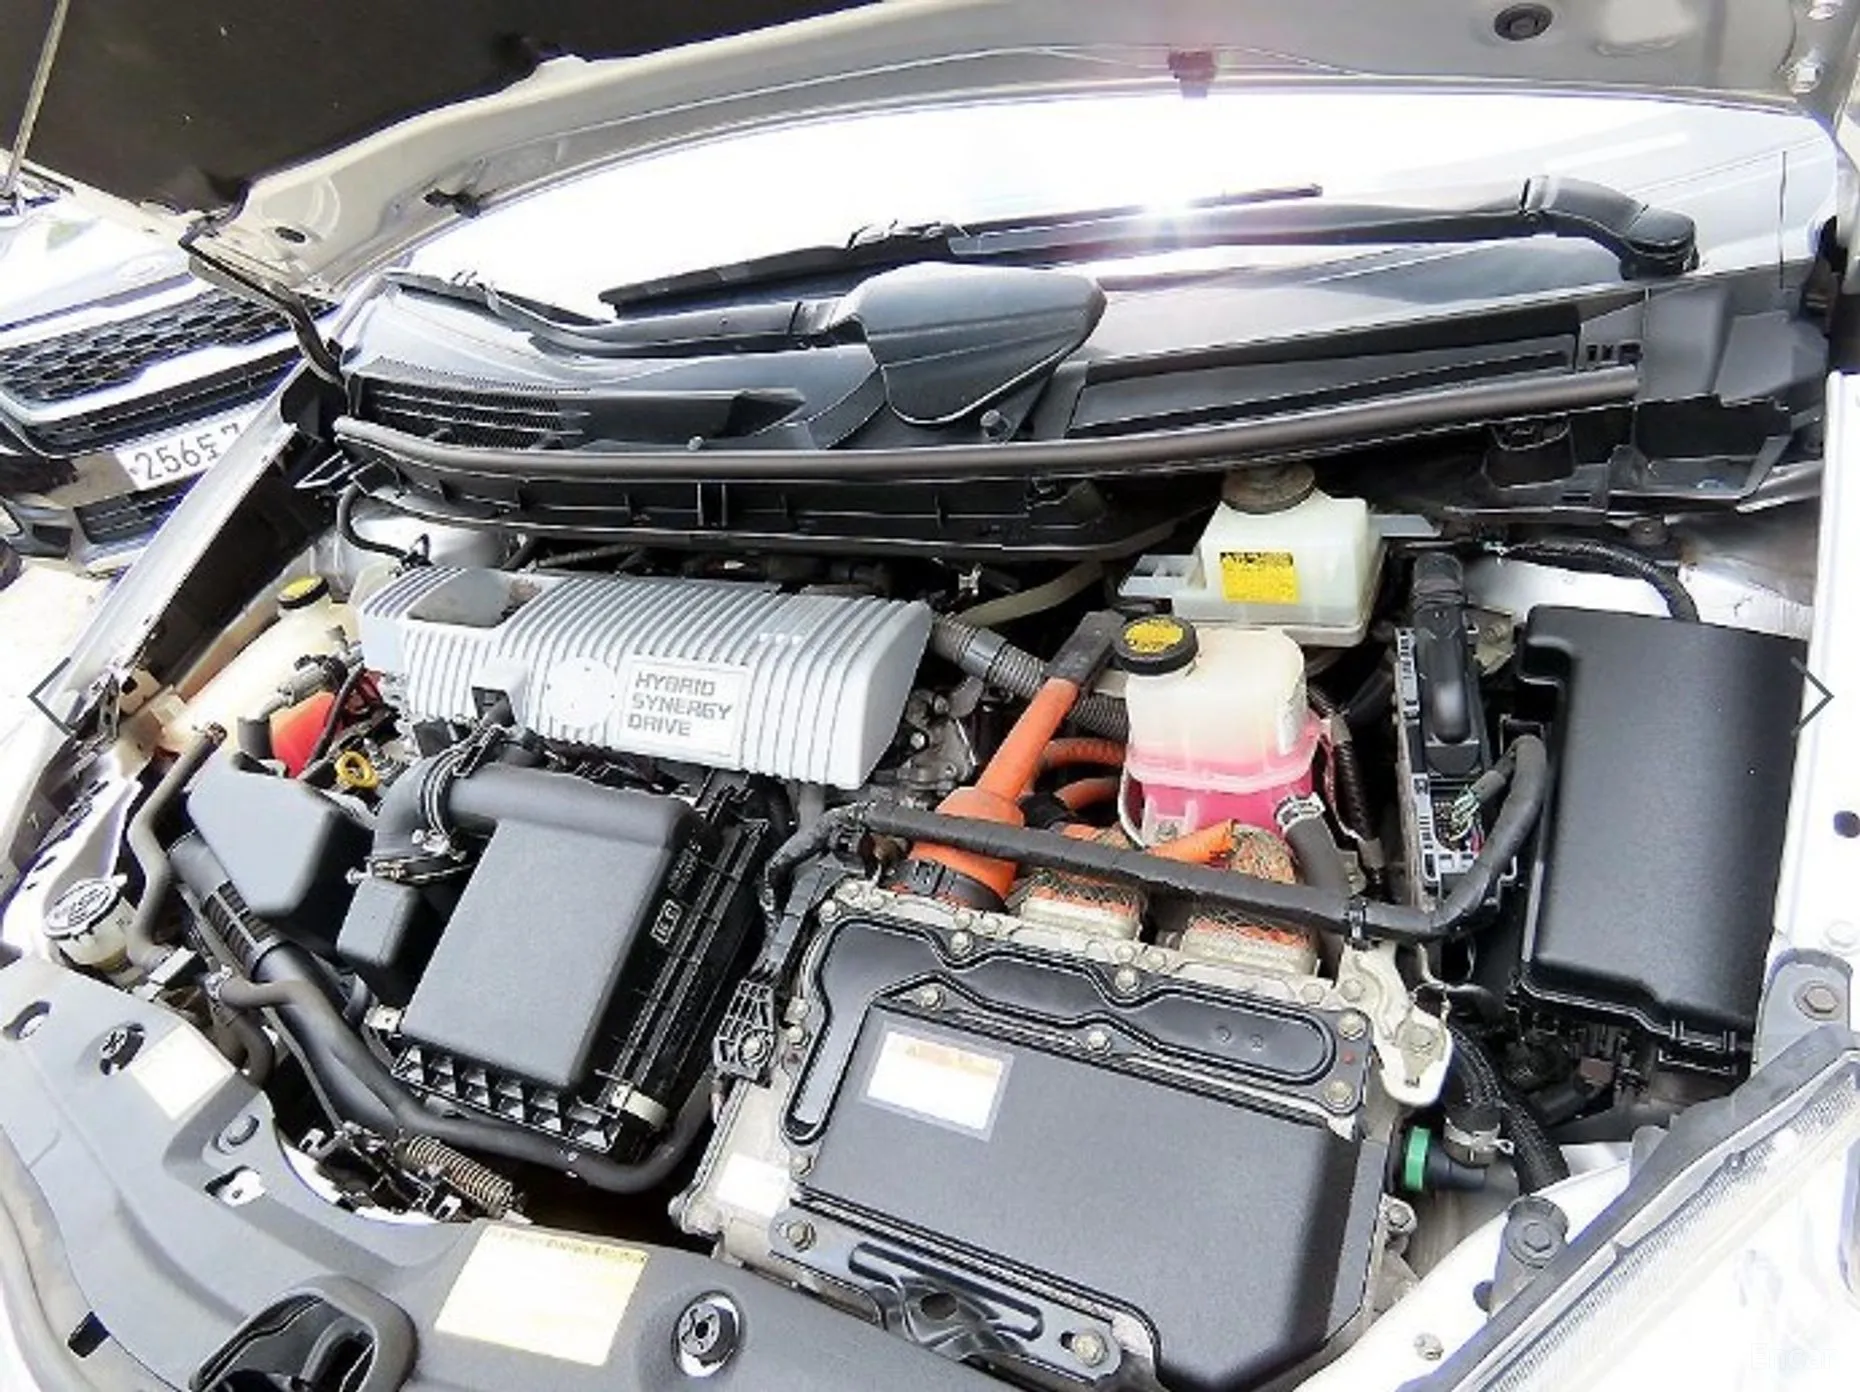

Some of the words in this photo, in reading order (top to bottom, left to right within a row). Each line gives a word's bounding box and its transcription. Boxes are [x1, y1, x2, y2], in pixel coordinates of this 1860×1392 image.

[634, 671, 717, 697] HYBRID
[632, 692, 733, 720] SYNERGY
[627, 713, 692, 736] DRIVE
